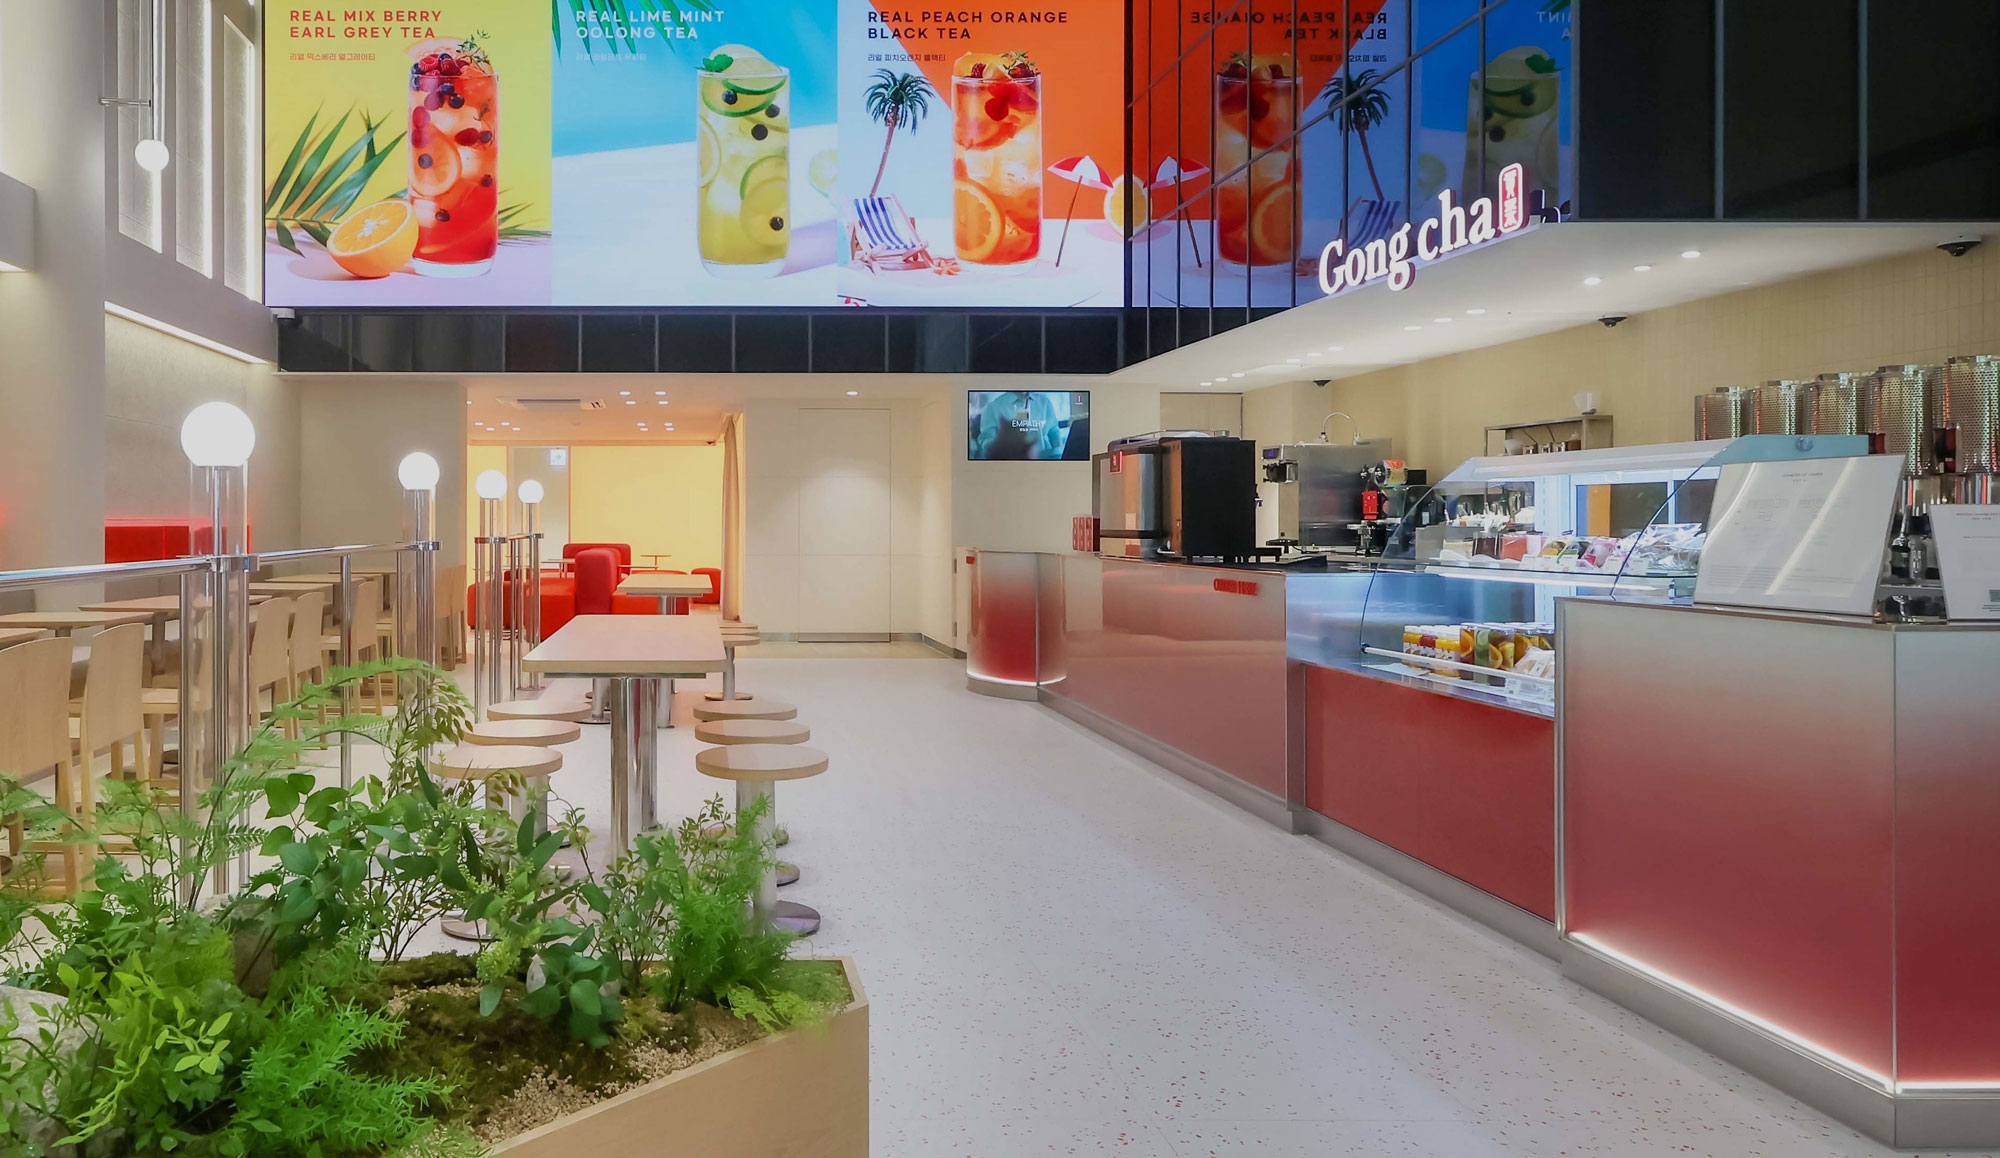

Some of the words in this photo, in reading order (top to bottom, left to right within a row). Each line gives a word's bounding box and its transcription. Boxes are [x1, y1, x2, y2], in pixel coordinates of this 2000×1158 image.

[290, 10, 335, 22] REAL
[344, 10, 375, 22] MIX
[384, 10, 441, 22] BERRY
[576, 10, 622, 22] REAL
[630, 10, 671, 22] LIME
[680, 10, 724, 22] MINT
[868, 11, 913, 23] REAL
[922, 11, 982, 23] PEACH
[991, 11, 1067, 23] ORANGE
[290, 27, 335, 38] EARL
[344, 27, 392, 38] GREY
[401, 27, 435, 38] TEA
[576, 27, 656, 39] OOLONG
[664, 27, 698, 39] TEA
[868, 27, 928, 39] BLACK
[936, 27, 971, 39] TEA
[1319, 222, 1412, 295] Gong
[1417, 188, 1497, 261] cha
